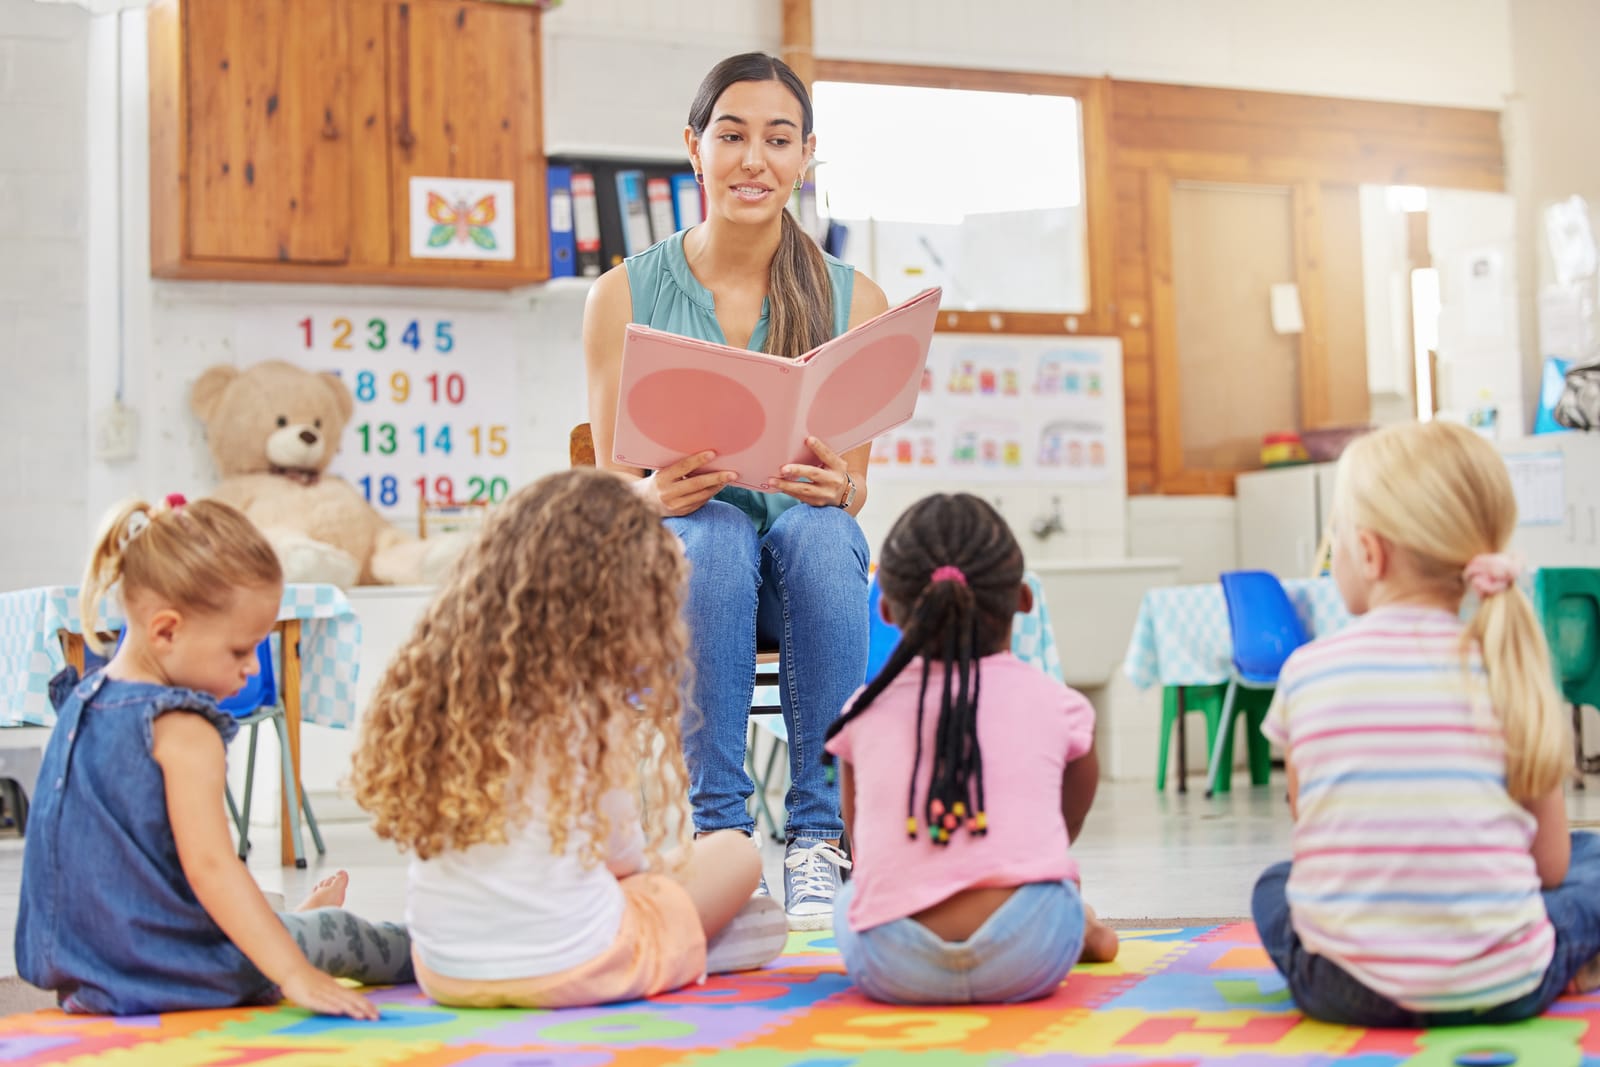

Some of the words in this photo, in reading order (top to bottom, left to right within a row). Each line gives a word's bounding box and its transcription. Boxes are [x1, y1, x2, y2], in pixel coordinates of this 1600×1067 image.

[299, 317, 314, 349] 1
[332, 318, 353, 350] 2
[367, 319, 388, 351] 3
[401, 320, 421, 351] 4
[435, 321, 455, 353] 5
[355, 371, 377, 402] 8
[389, 371, 410, 403] 9
[426, 373, 466, 404] 10
[357, 424, 398, 455] 13
[413, 424, 454, 455] 14
[468, 426, 508, 457] 15
[359, 475, 399, 507] 18
[414, 476, 455, 506] 19
[467, 477, 509, 505] 20
[811, 1013, 991, 1047] 3
[1114, 1016, 1304, 1045] H
